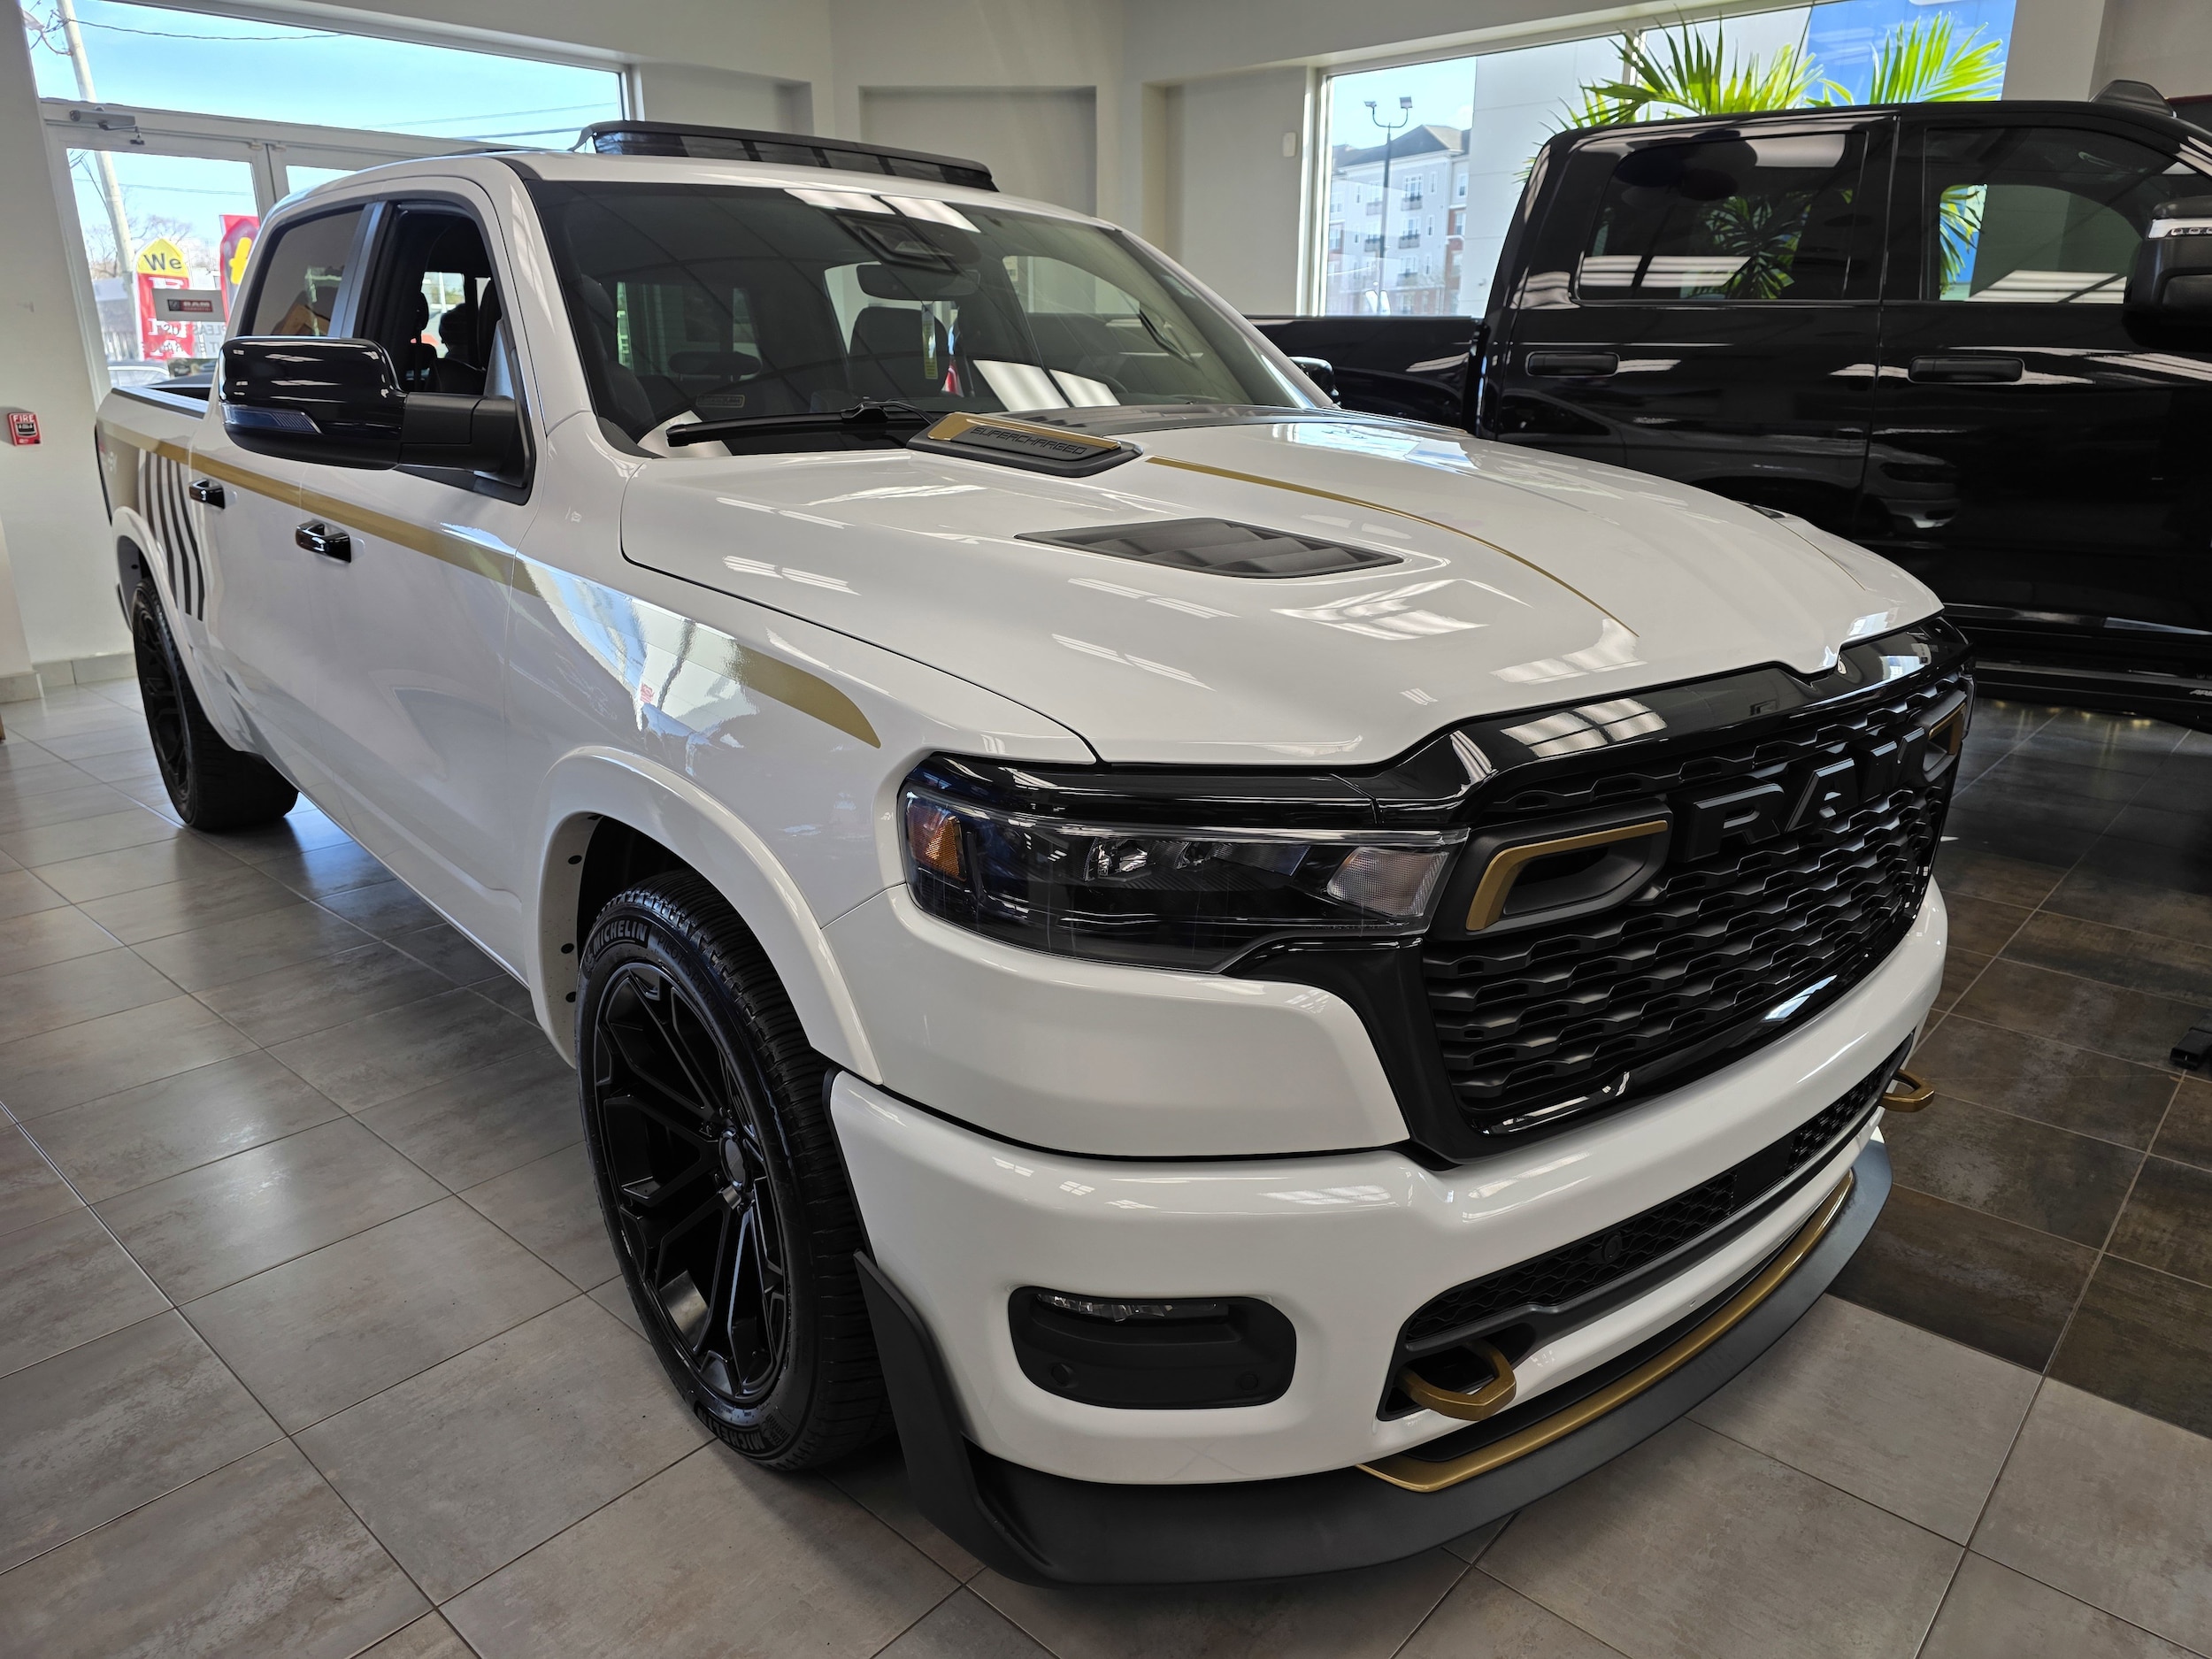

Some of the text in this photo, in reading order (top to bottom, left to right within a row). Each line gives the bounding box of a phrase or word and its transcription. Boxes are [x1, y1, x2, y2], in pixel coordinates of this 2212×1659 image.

[143, 252, 182, 271] We
[13, 414, 35, 423] FIRE
[971, 427, 1087, 455] SUPERCHARGED
[1685, 726, 1925, 863] RAM
[593, 919, 647, 949] MICHELIN
[657, 934, 683, 965] PILOT
[697, 1406, 765, 1450] MICHELIN
